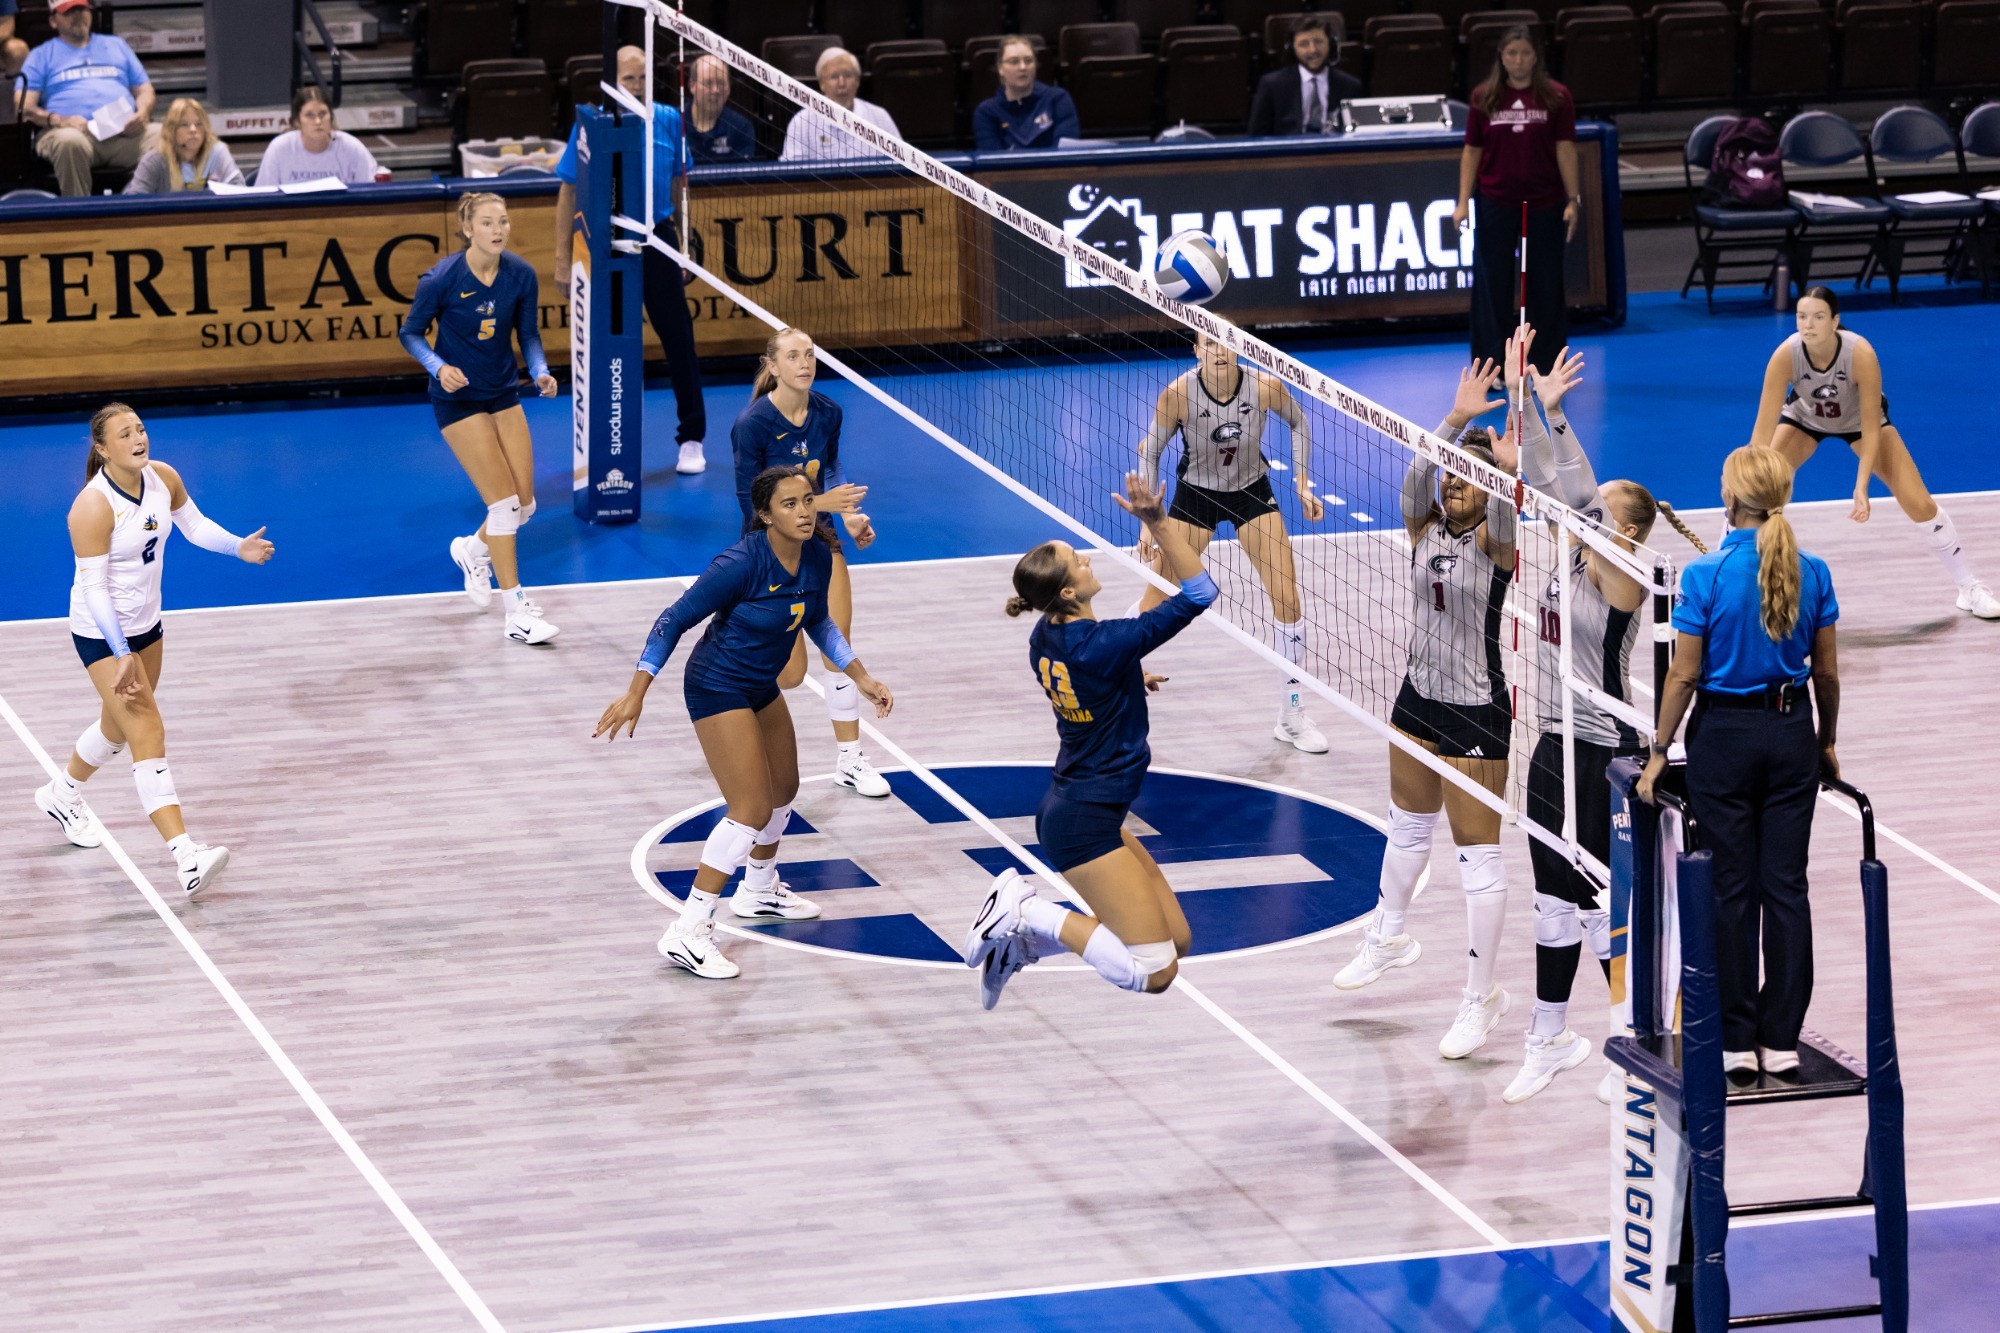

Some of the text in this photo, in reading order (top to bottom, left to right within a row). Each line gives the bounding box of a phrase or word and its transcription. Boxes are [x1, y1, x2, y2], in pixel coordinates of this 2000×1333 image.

[226, 117, 274, 129] BUFFET
[1300, 277, 1338, 297] LATE
[1347, 274, 1396, 294] NIGHT
[1405, 271, 1447, 291] DONE
[201, 313, 434, 349] SIOUX FALL
[477, 318, 497, 341] 5
[574, 276, 586, 456] PENTAGON
[1242, 339, 1312, 390] PENTAGON VOLLEYBALL
[608, 357, 623, 456] sports imports
[1336, 390, 1410, 444] PENTAGON VOLLEYBALL
[1814, 401, 1842, 419] 13
[1219, 446, 1238, 467] 7
[1437, 444, 1473, 477] PENTAGON
[596, 479, 635, 492] PENTAGON
[141, 535, 159, 566] 2
[1431, 581, 1446, 612] 1
[785, 601, 806, 633] 7
[1539, 606, 1561, 647] 10
[1623, 1068, 1658, 1295] NTAGON
